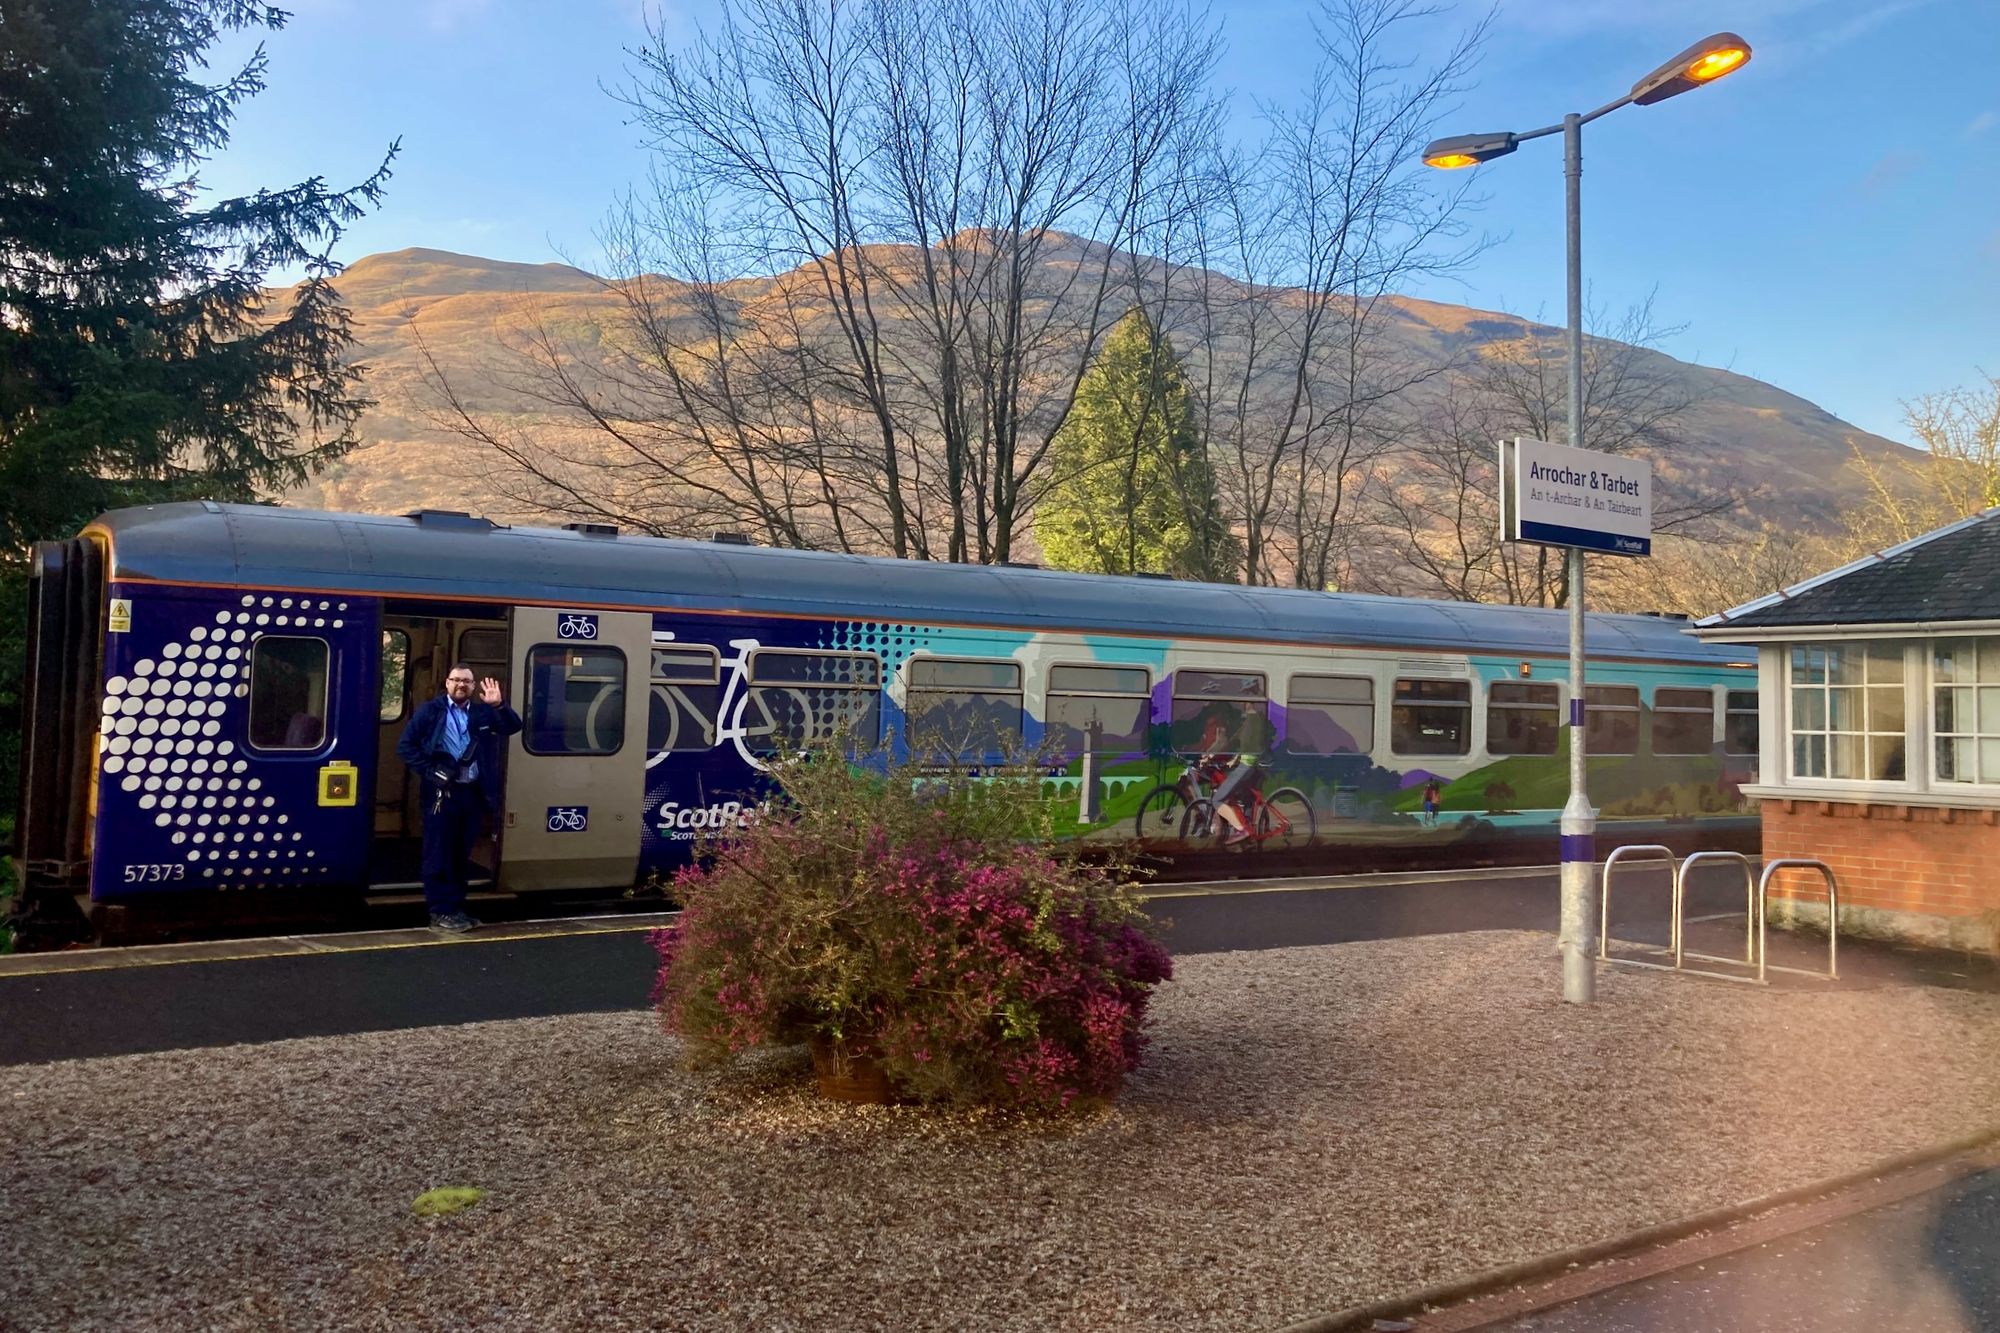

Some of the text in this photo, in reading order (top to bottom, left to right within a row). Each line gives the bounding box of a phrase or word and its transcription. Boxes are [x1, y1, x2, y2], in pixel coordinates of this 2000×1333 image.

[1530, 461, 1639, 496] Arrochar & Tarbet
[1531, 488, 1543, 500] An
[1584, 496, 1591, 508] &
[1593, 498, 1605, 510] An
[1608, 500, 1642, 517] Tairbeart
[124, 864, 184, 882] 57373
